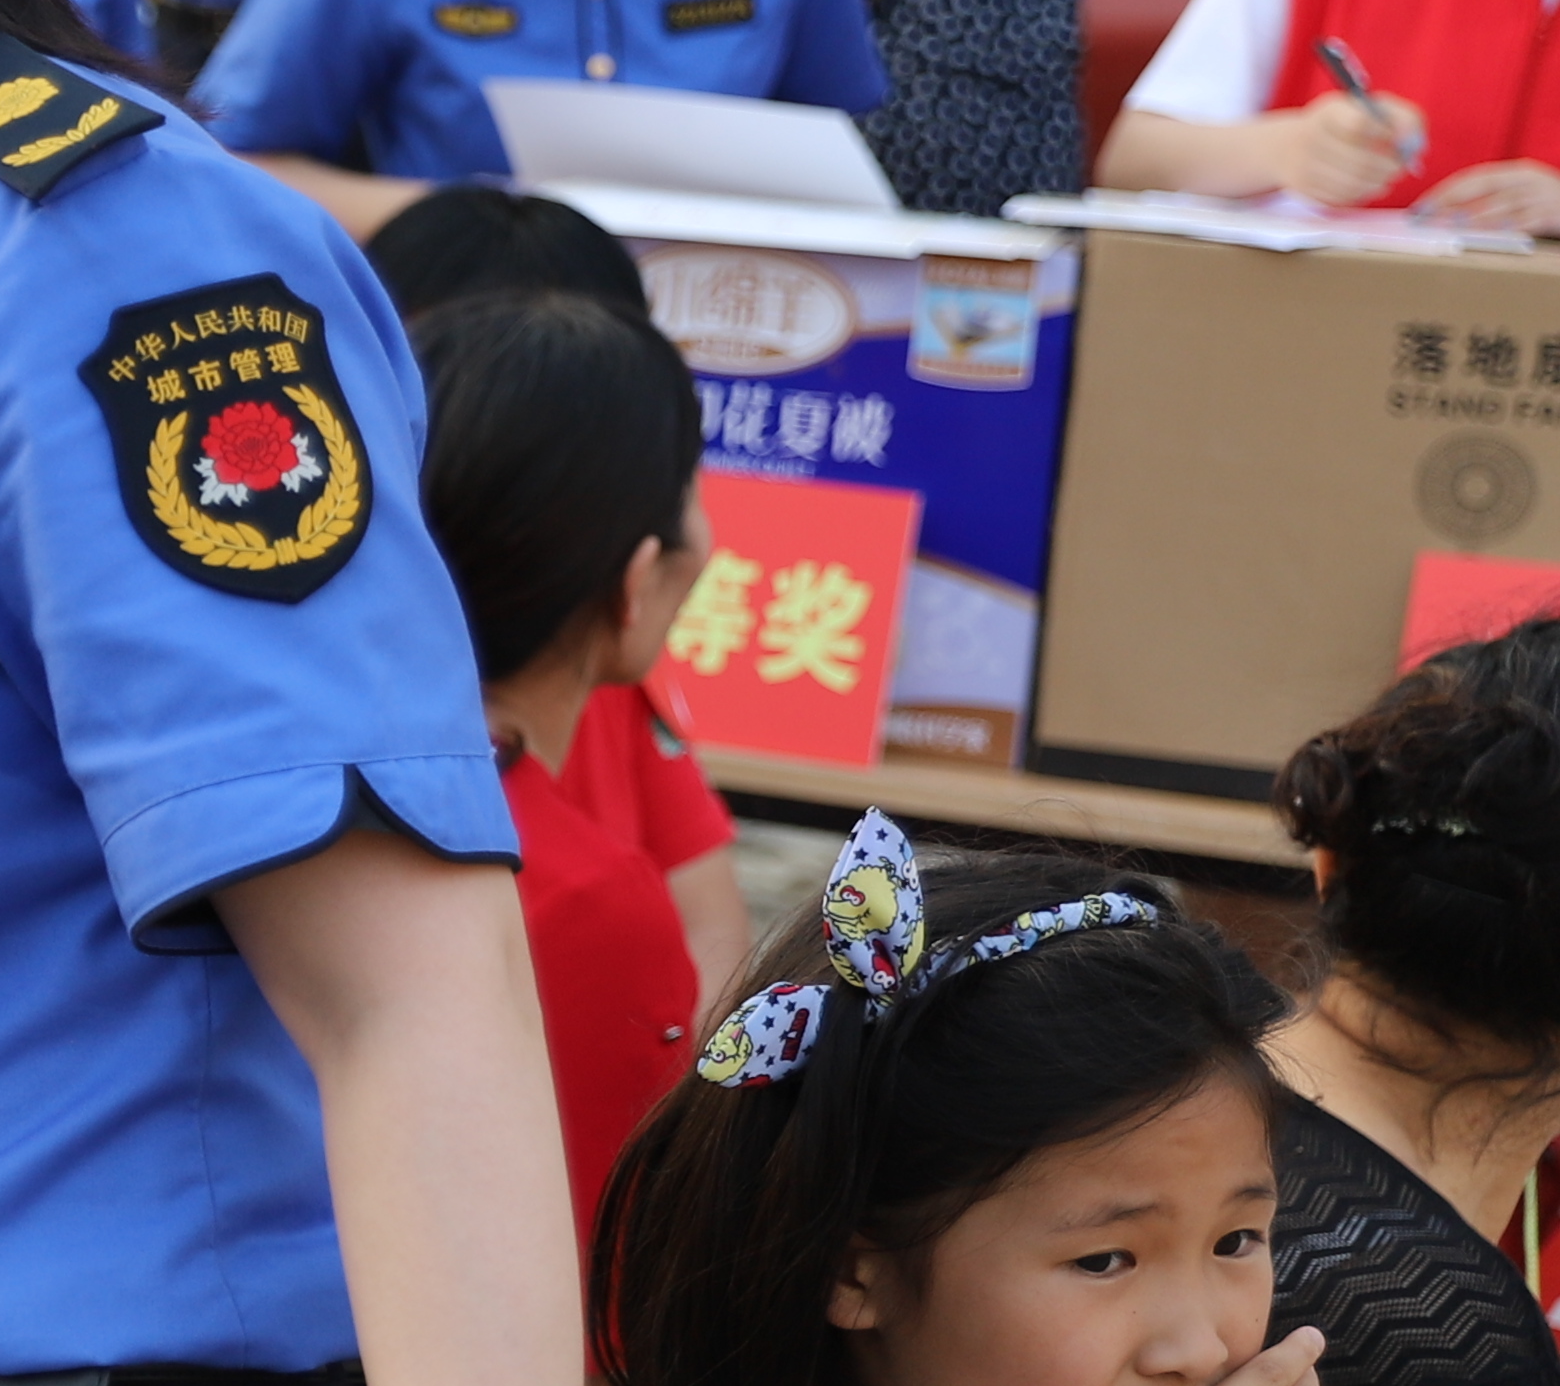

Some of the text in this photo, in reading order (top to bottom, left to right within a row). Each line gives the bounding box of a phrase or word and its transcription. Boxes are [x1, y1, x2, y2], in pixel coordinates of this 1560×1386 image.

[108, 305, 308, 383] 中华人民共和国
[146, 341, 301, 404] 城市管理
